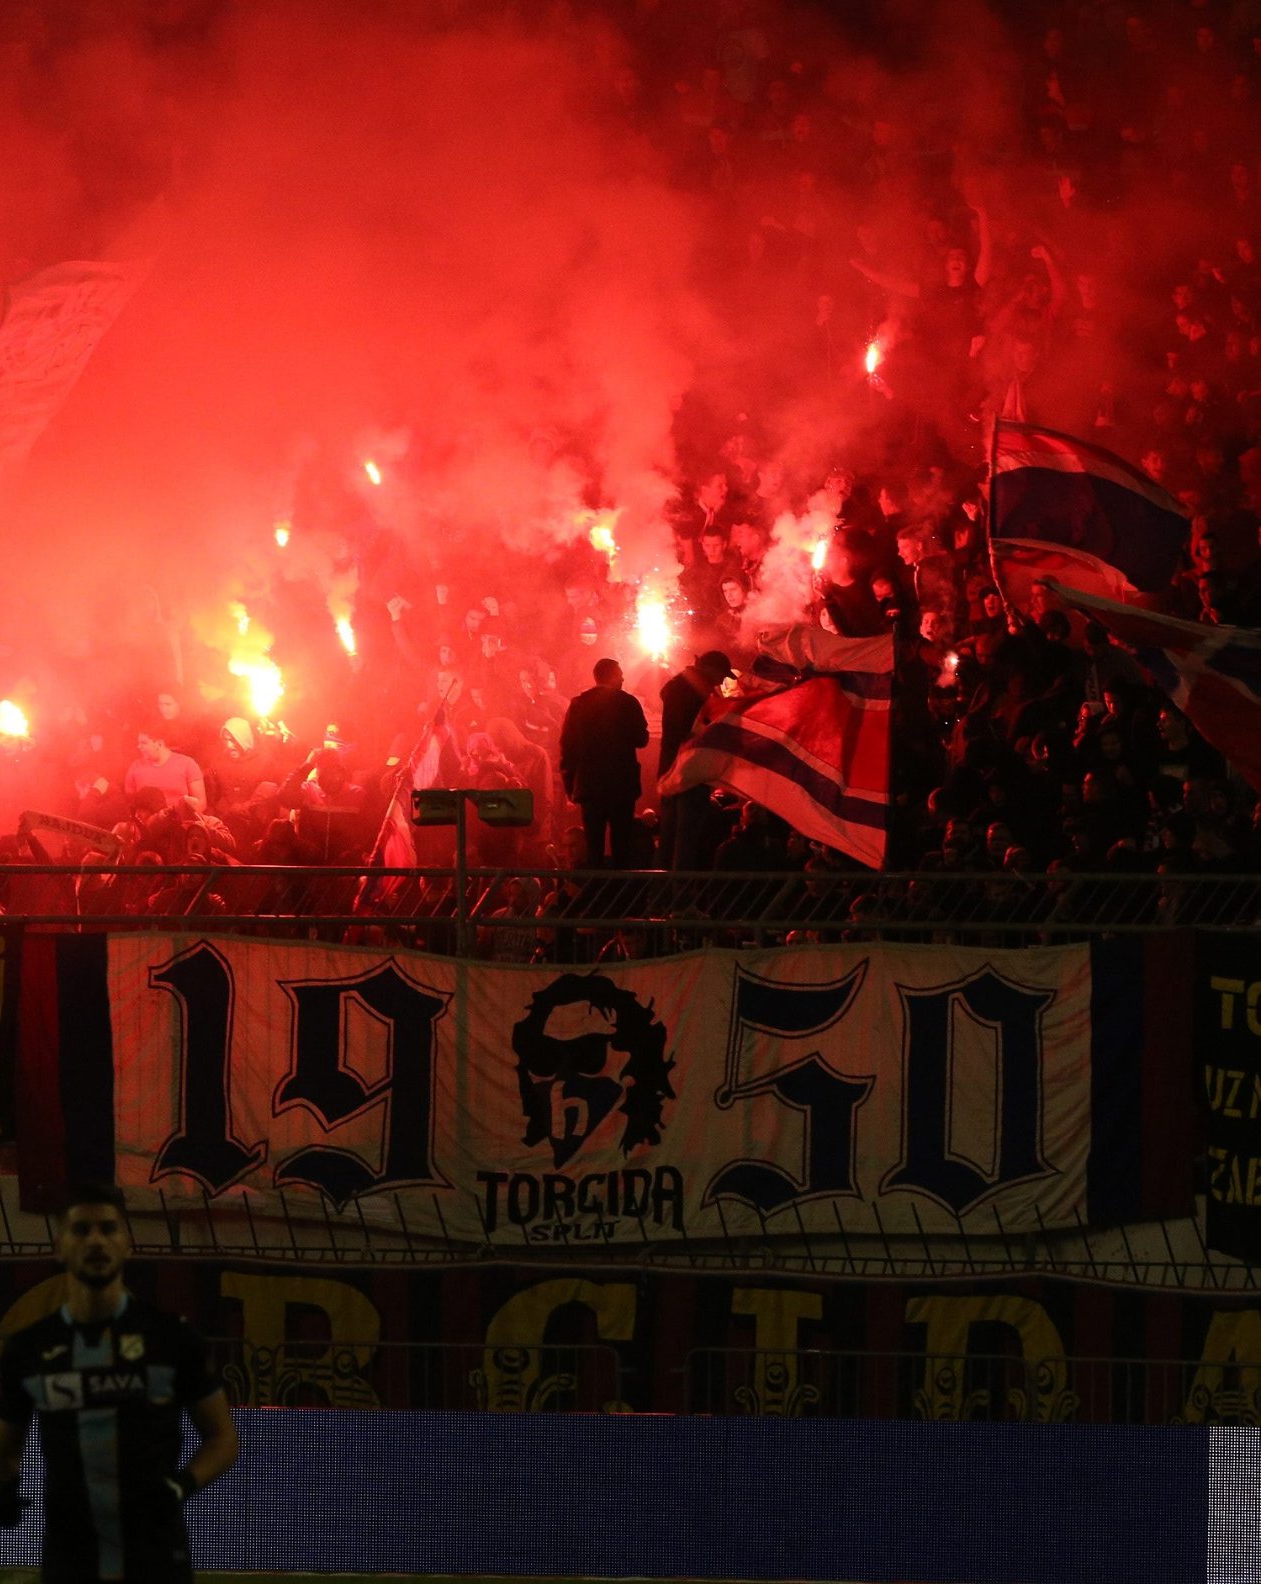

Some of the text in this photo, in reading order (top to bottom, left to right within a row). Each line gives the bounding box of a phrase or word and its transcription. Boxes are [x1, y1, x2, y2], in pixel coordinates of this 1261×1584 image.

[476, 1165, 684, 1233] TORCIDA
[530, 1220, 620, 1241] SPLIT
[89, 1373, 145, 1393] SAVA
